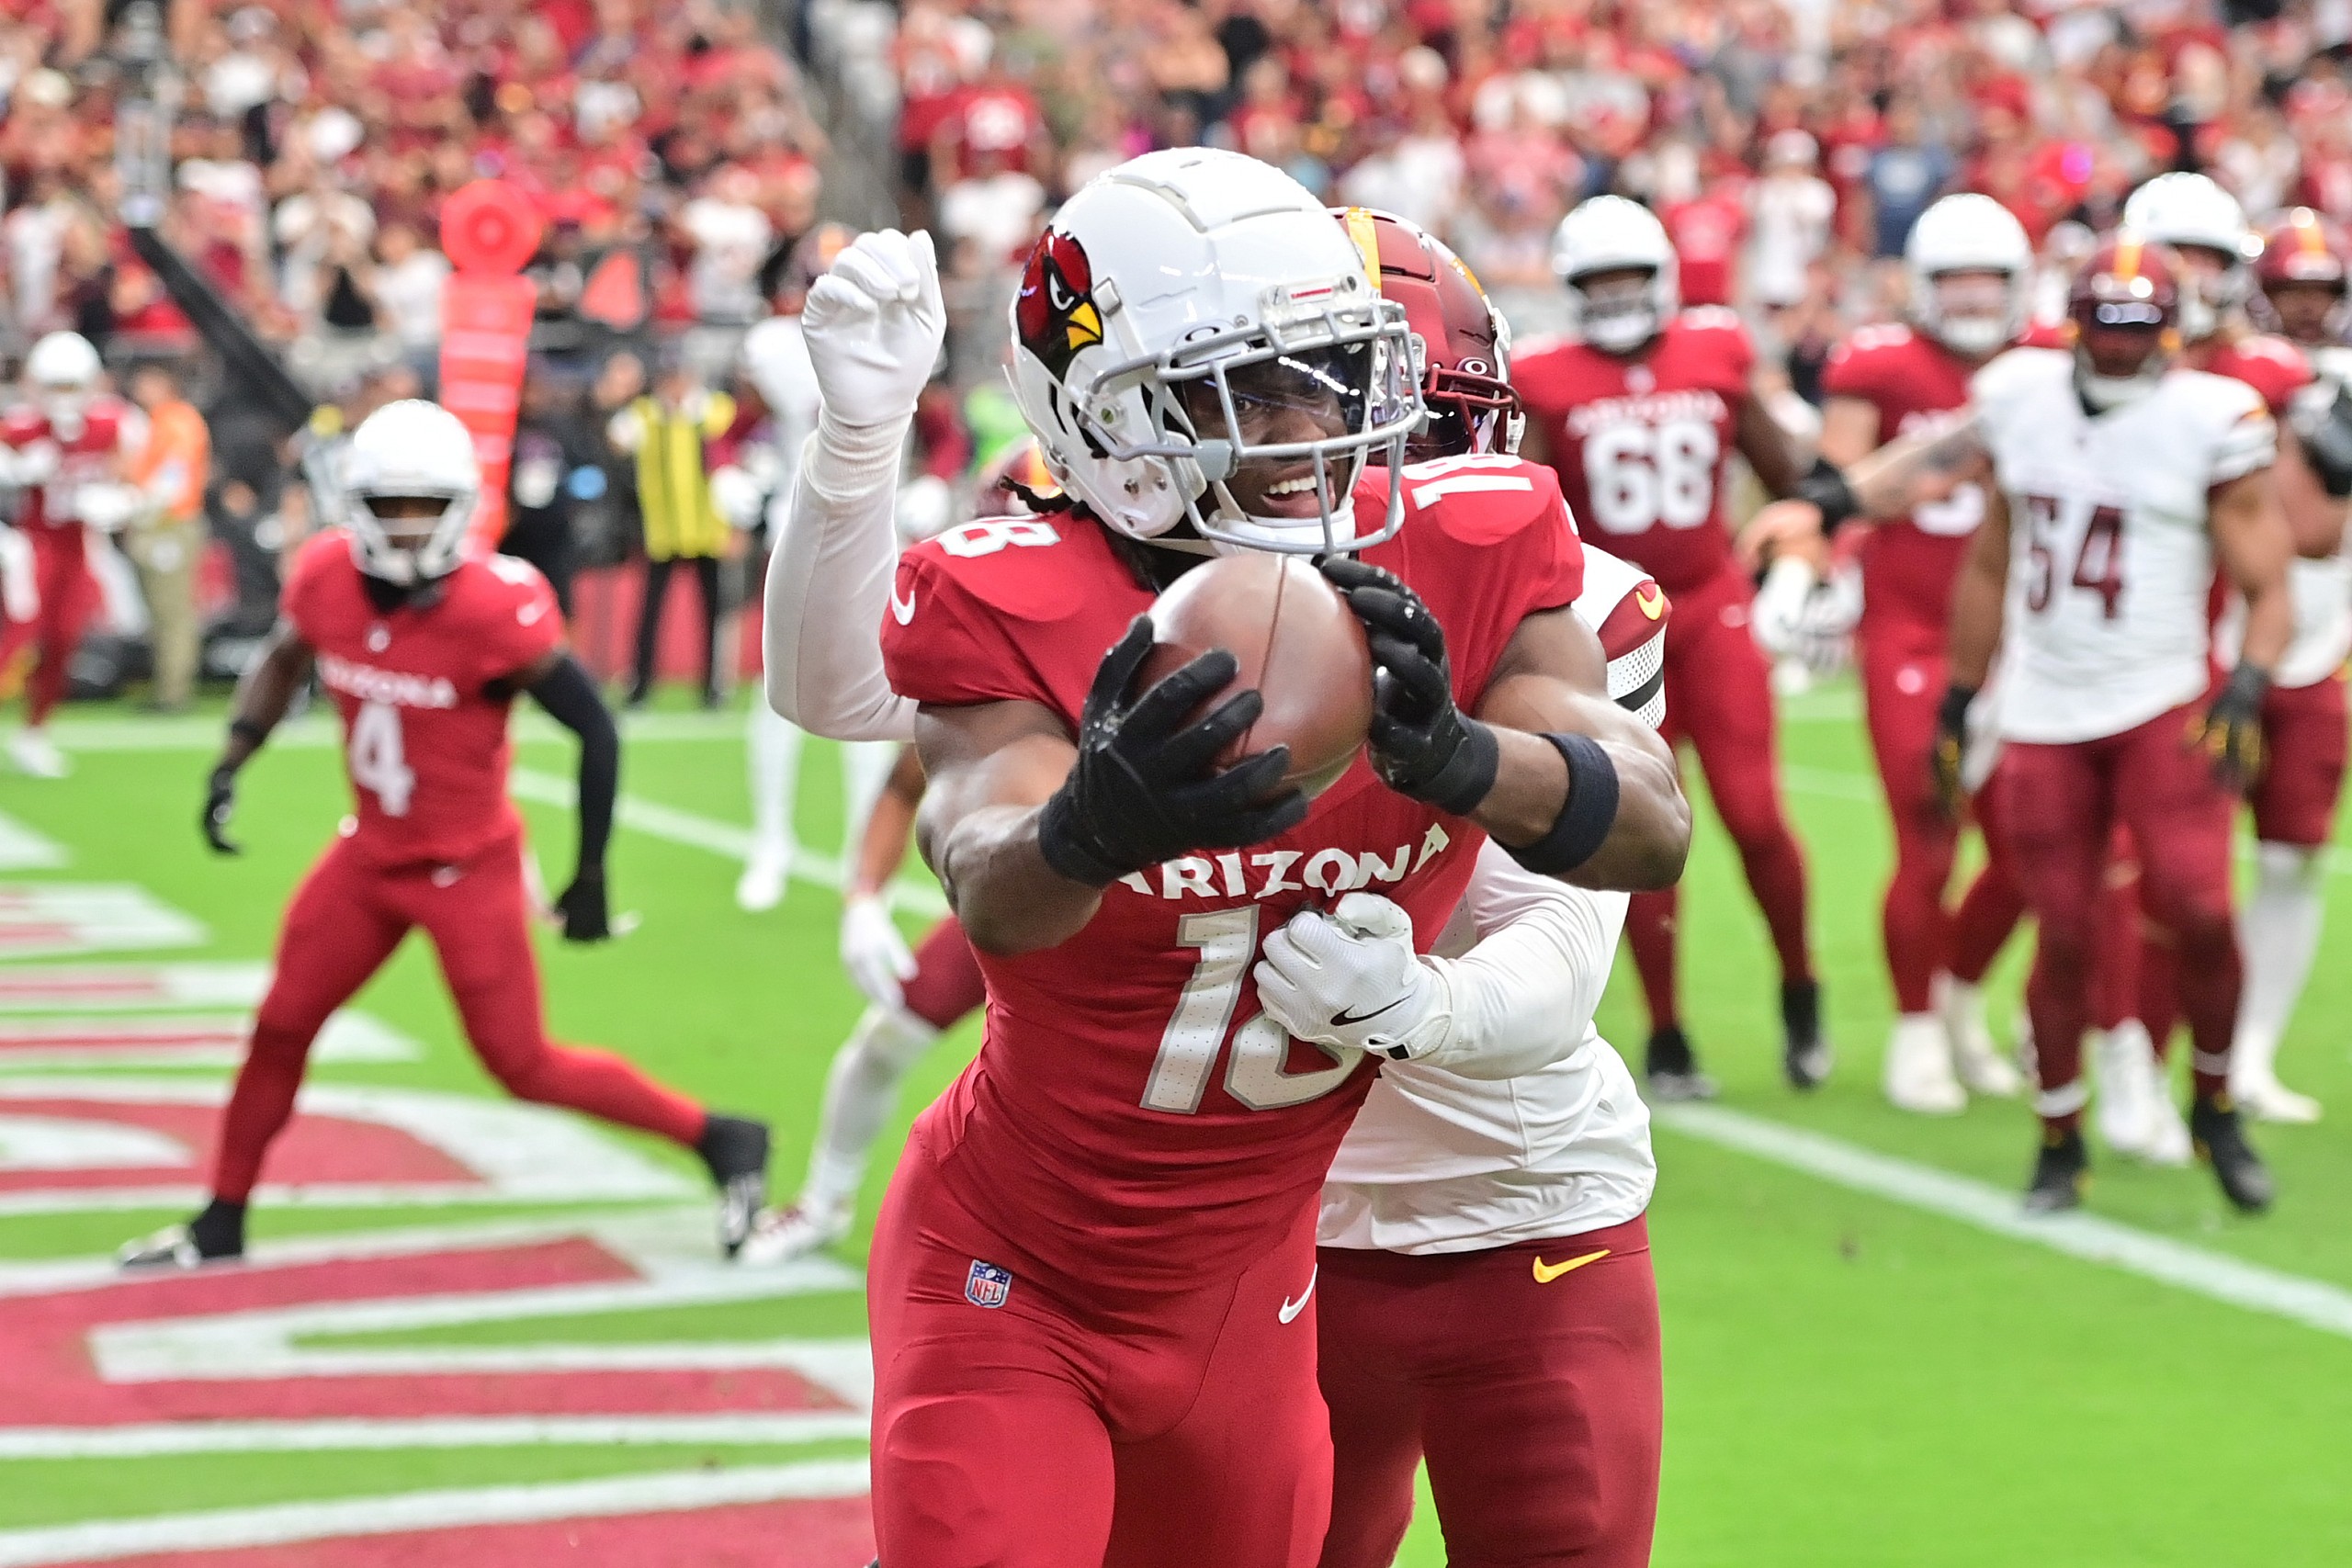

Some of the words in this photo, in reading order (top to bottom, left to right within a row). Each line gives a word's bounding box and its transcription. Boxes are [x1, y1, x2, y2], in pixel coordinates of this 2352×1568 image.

[1583, 421, 1719, 535] 68
[2025, 491, 2128, 623] 54
[351, 700, 416, 817] 4
[1118, 823, 1450, 899] RIZONA
[971, 1278, 1001, 1303] NFL
